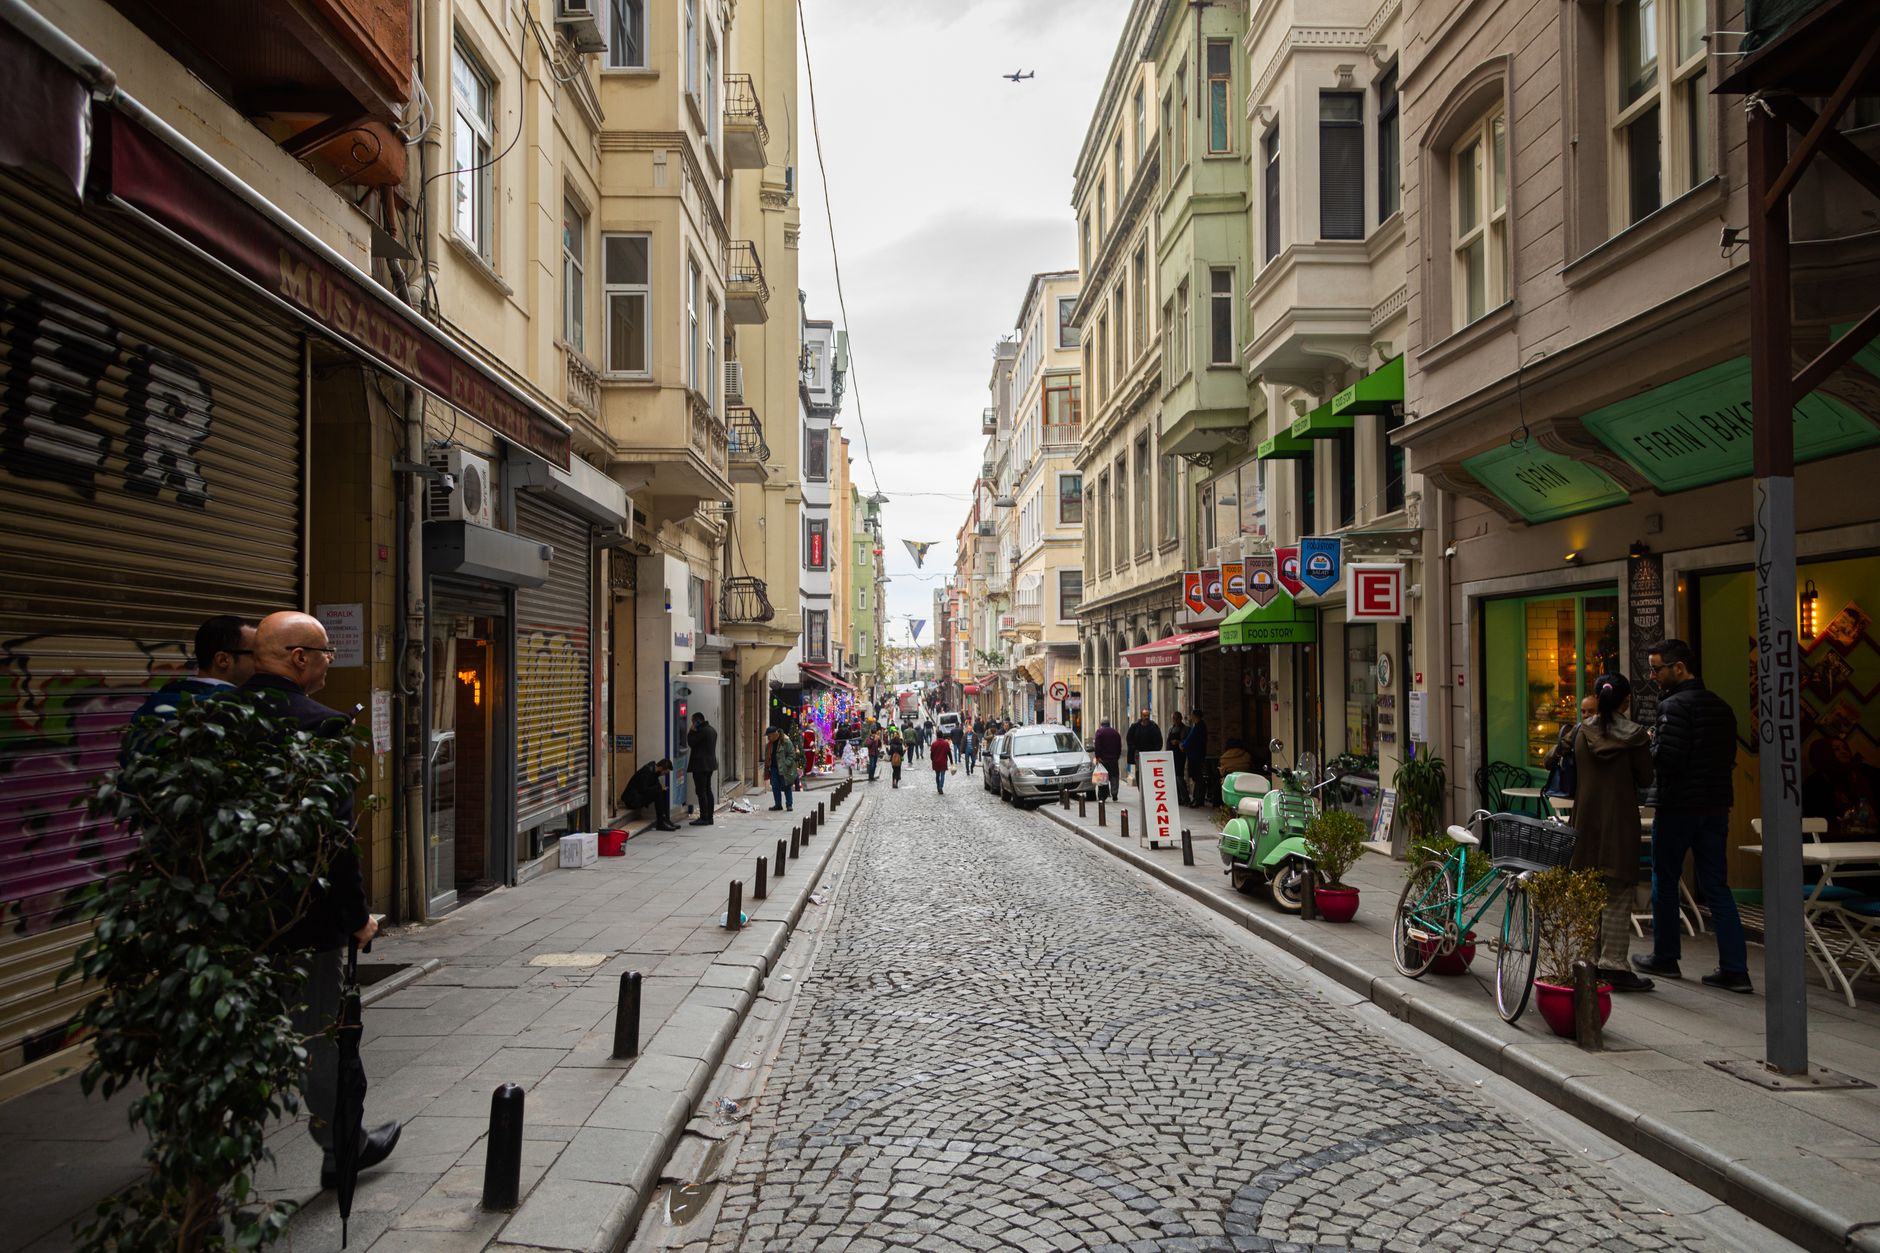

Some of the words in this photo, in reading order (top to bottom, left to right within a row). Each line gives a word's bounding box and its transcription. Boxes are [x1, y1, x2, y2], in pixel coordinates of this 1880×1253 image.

[278, 247, 425, 379] MUSATEK
[1632, 423, 1706, 462] FIRIN
[1307, 542, 1320, 550] FOOD
[1320, 542, 1336, 550] STORY
[1364, 576, 1391, 610] E
[1248, 629, 1268, 639] FOOD
[1270, 627, 1294, 638] STORY
[1153, 767, 1170, 838] ECZANE
